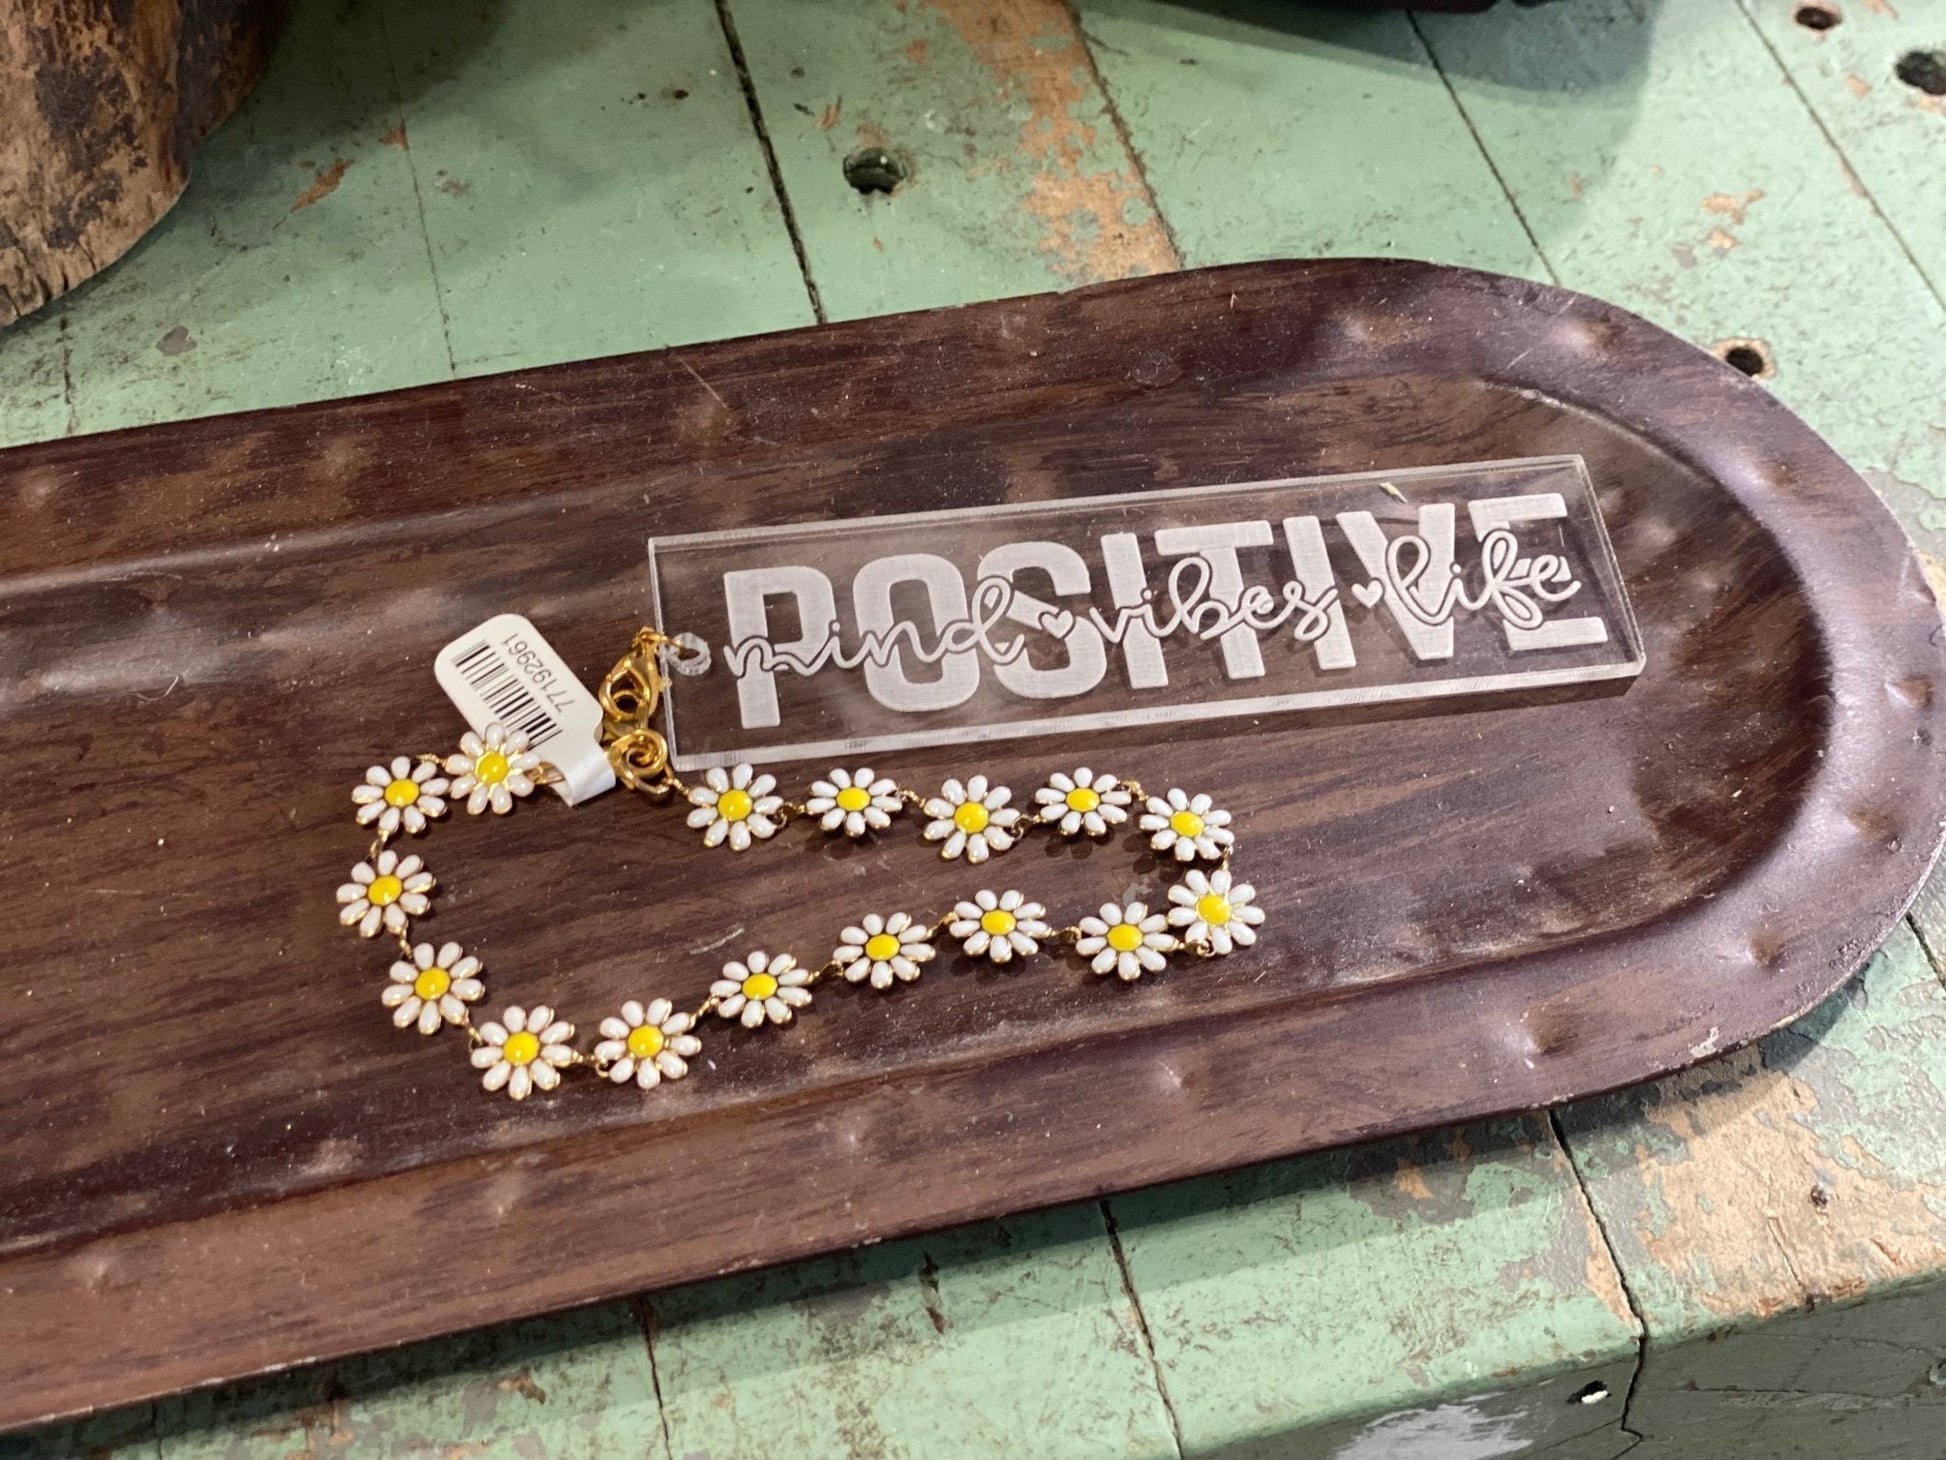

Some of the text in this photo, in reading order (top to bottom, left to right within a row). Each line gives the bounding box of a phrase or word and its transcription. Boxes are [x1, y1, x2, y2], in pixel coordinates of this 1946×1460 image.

[502, 632, 576, 714] 77192961
[723, 529, 1581, 681] mind vibes life
[723, 492, 1608, 729] POSITIVE
